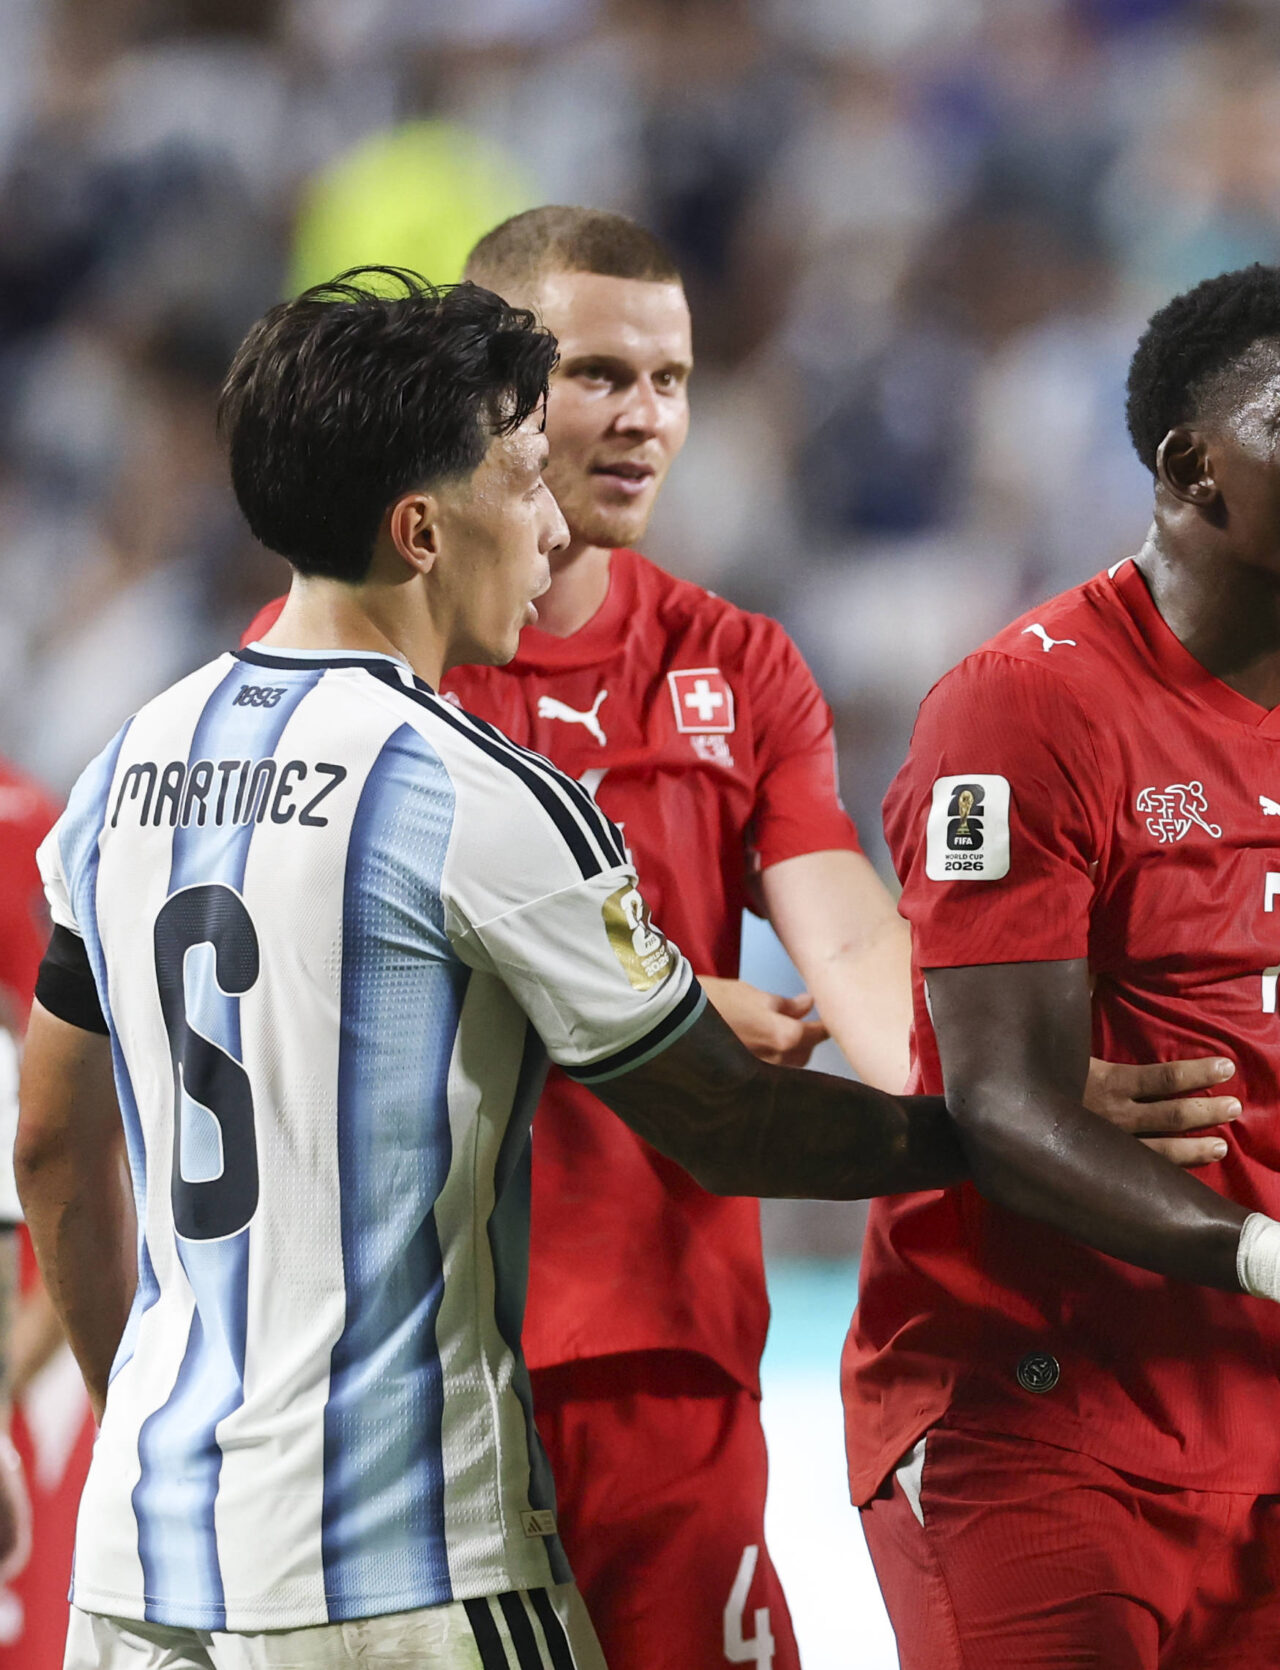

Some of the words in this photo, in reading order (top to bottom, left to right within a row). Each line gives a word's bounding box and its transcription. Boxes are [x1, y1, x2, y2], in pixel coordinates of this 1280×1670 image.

[232, 684, 288, 708] 1893
[110, 759, 347, 828] MARTINEZ
[954, 836, 973, 845] FIFA
[945, 861, 984, 871] 2026
[153, 884, 260, 1242] 6
[723, 1544, 775, 1670] 4
